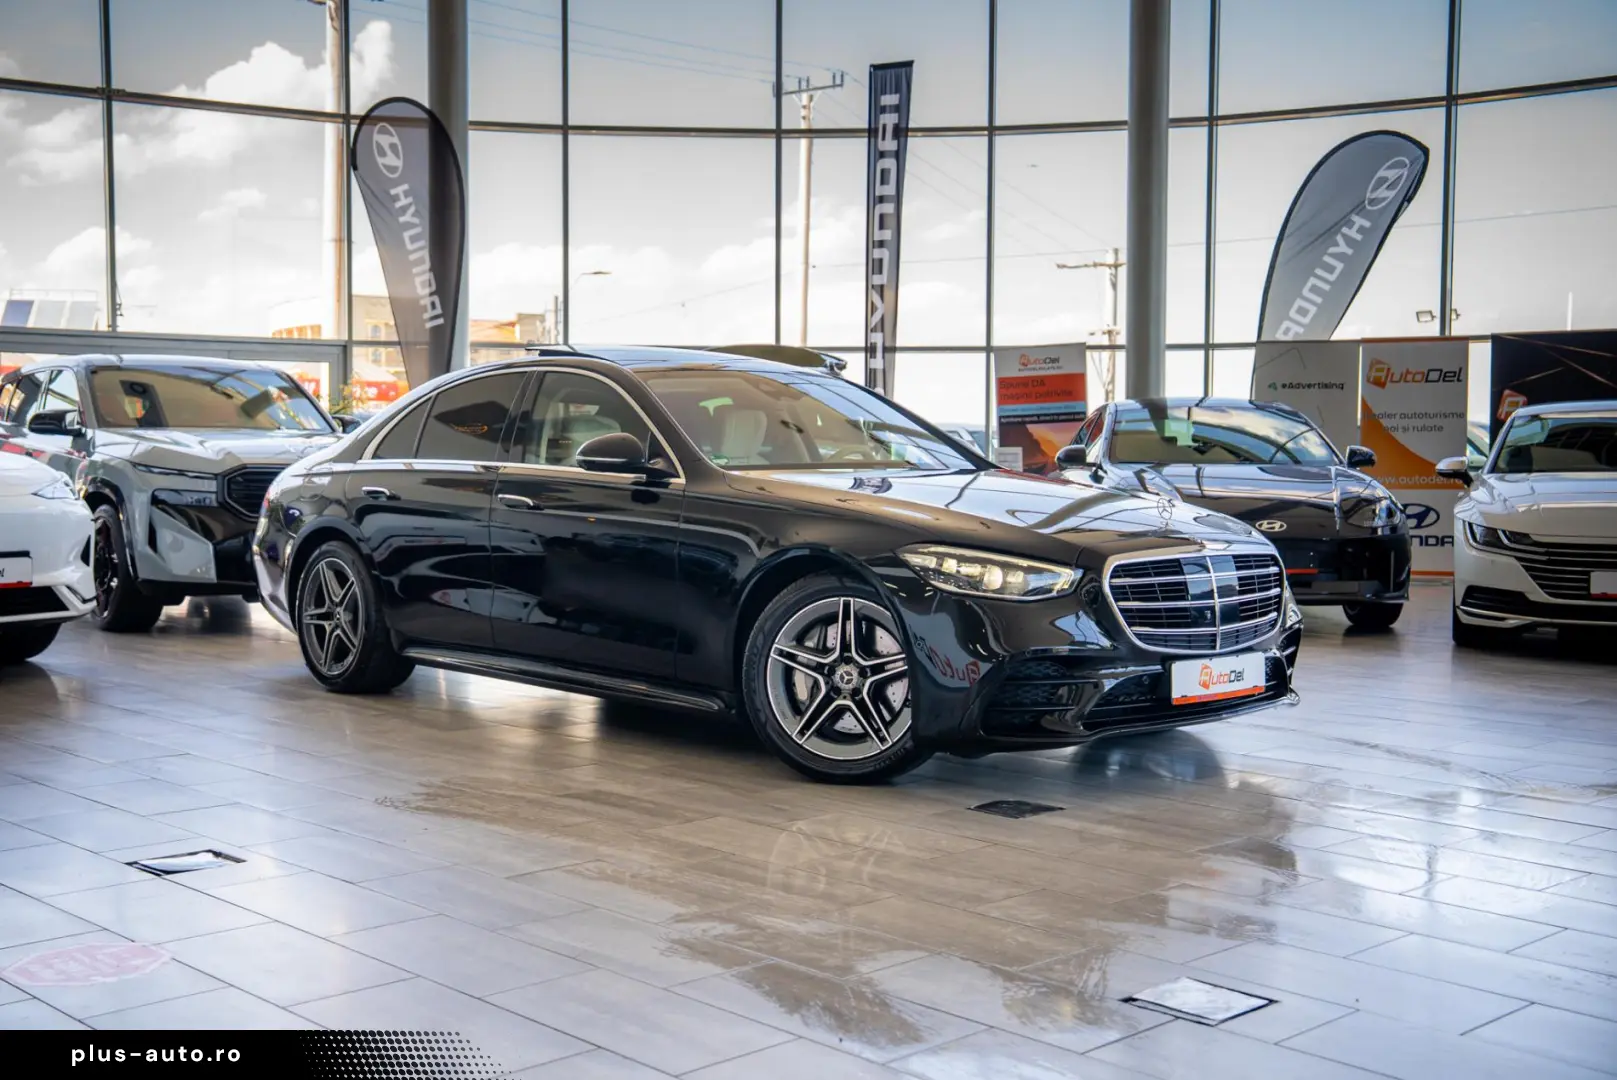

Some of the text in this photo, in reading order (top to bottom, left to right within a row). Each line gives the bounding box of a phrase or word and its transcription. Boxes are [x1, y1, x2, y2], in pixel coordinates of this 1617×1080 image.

[869, 93, 900, 370] HYUNDAI
[389, 183, 445, 329] HYUNDAI
[1366, 358, 1463, 389] AutoDel
[1281, 381, 1345, 391] eAdvertising
[1400, 411, 1465, 420] autoturisme
[1412, 424, 1444, 433] rulate
[1376, 474, 1463, 484] ww.autodel.ro
[1199, 663, 1245, 690] AutoDel
